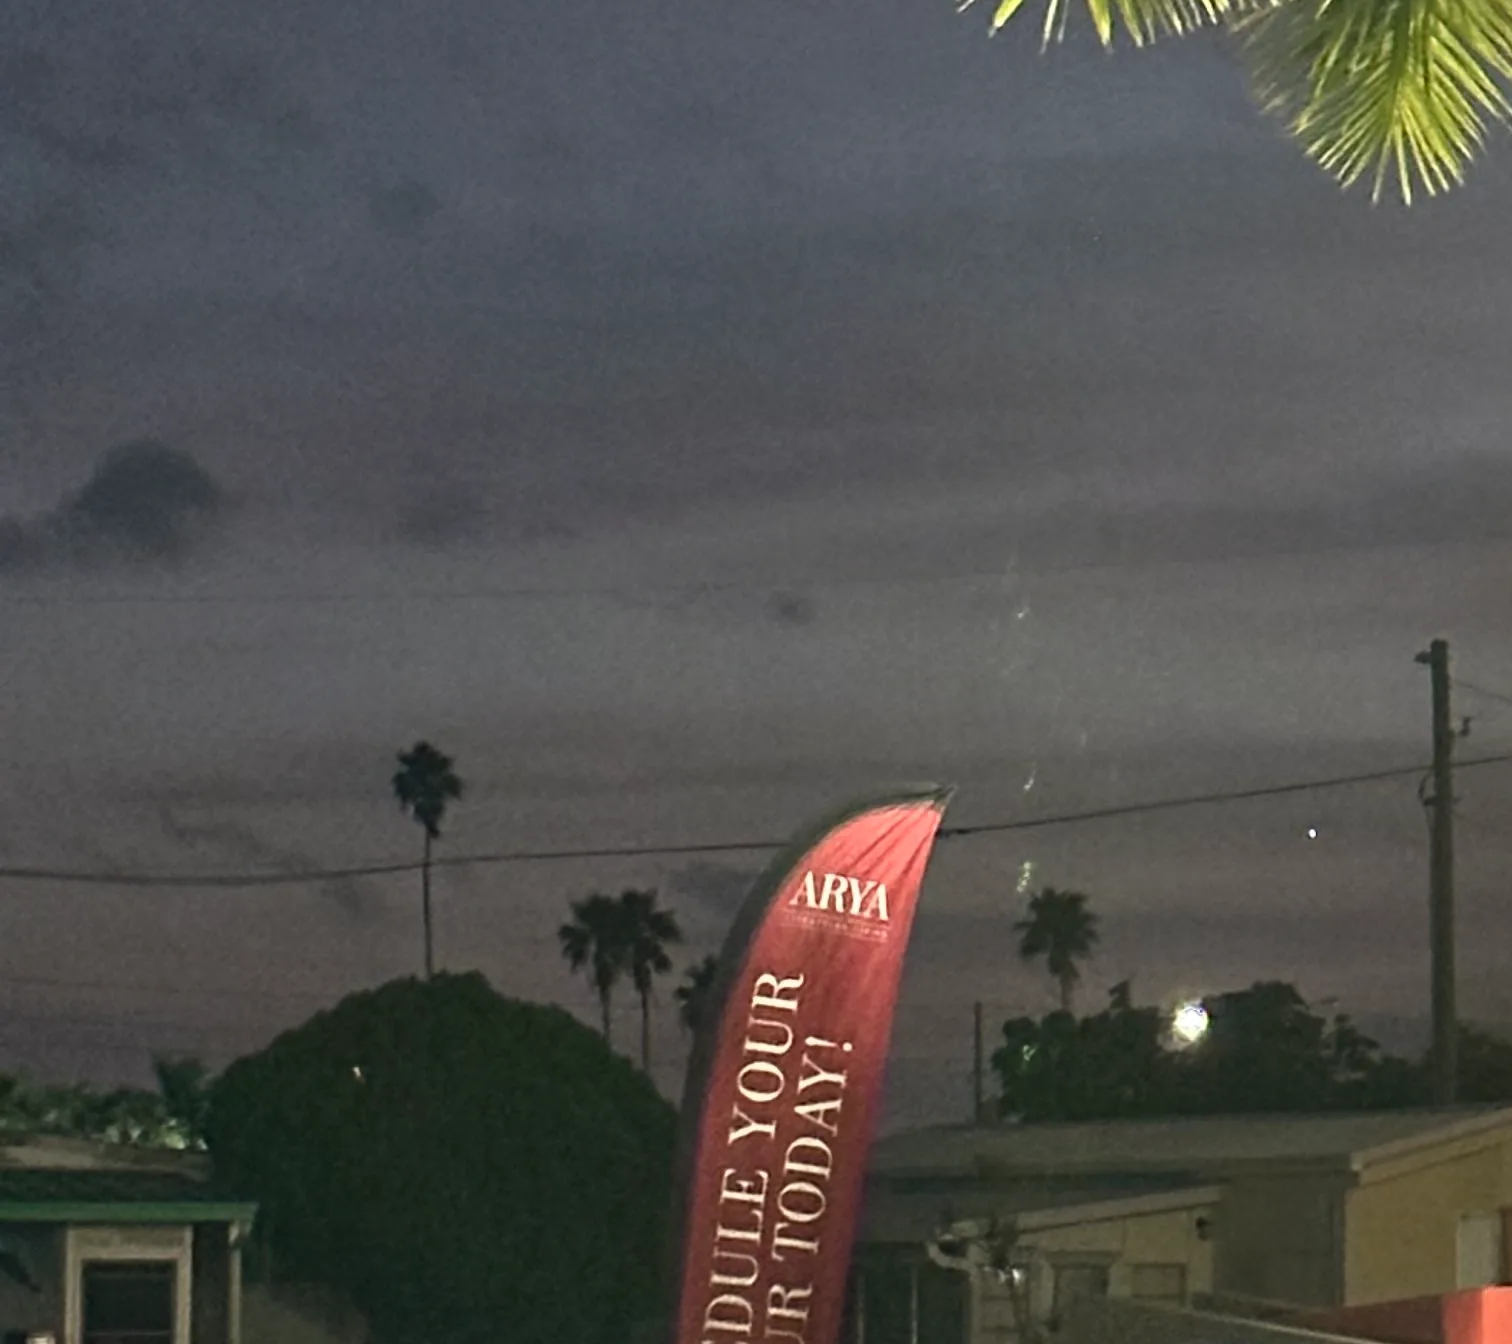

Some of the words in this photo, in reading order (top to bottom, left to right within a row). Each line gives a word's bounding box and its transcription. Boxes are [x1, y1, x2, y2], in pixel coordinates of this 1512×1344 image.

[788, 870, 889, 921] ARYA
[727, 972, 805, 1145] YOUR
[771, 1036, 853, 1262] TODAY!
